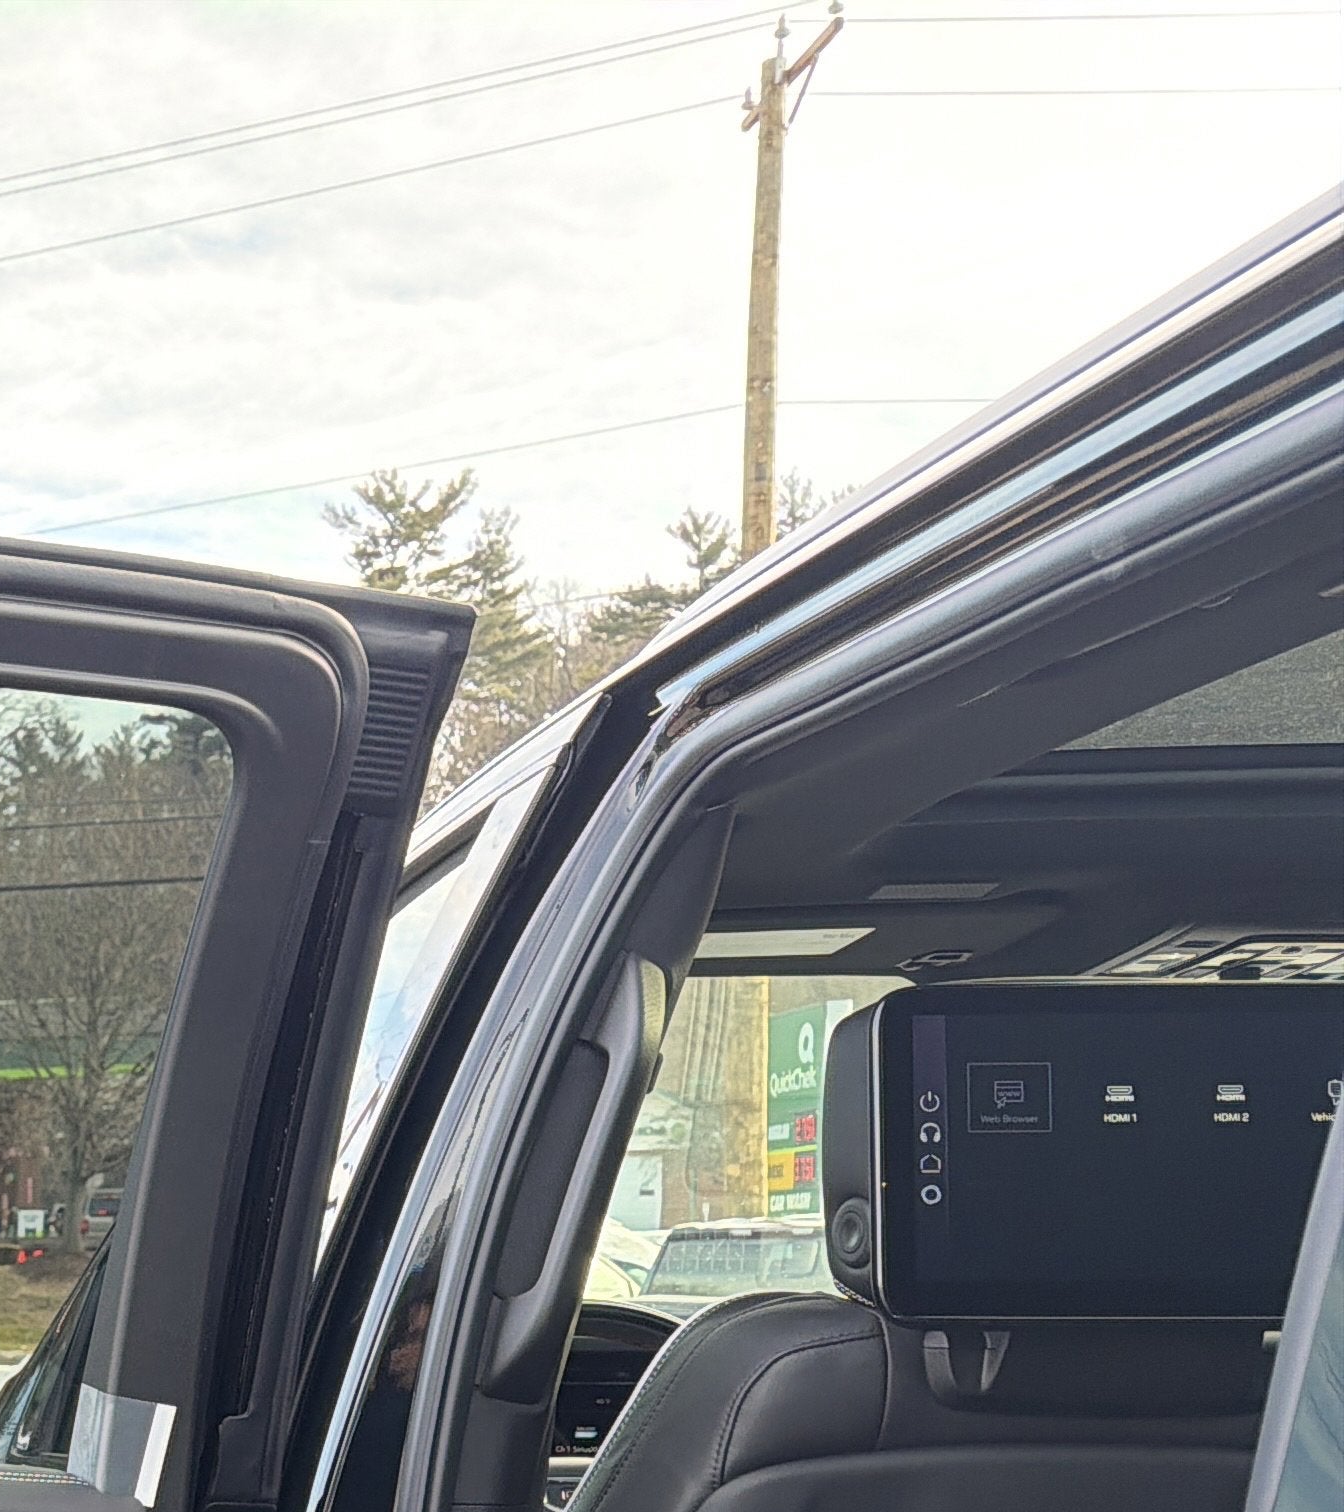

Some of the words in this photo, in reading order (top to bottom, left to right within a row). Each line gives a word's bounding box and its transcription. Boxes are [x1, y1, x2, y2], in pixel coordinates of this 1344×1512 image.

[980, 1115, 1001, 1123] Web
[1003, 1114, 1038, 1123] Browser
[1104, 1113, 1130, 1123] HDMI
[1214, 1113, 1240, 1123] HDMI
[1242, 1113, 1250, 1122] 2
